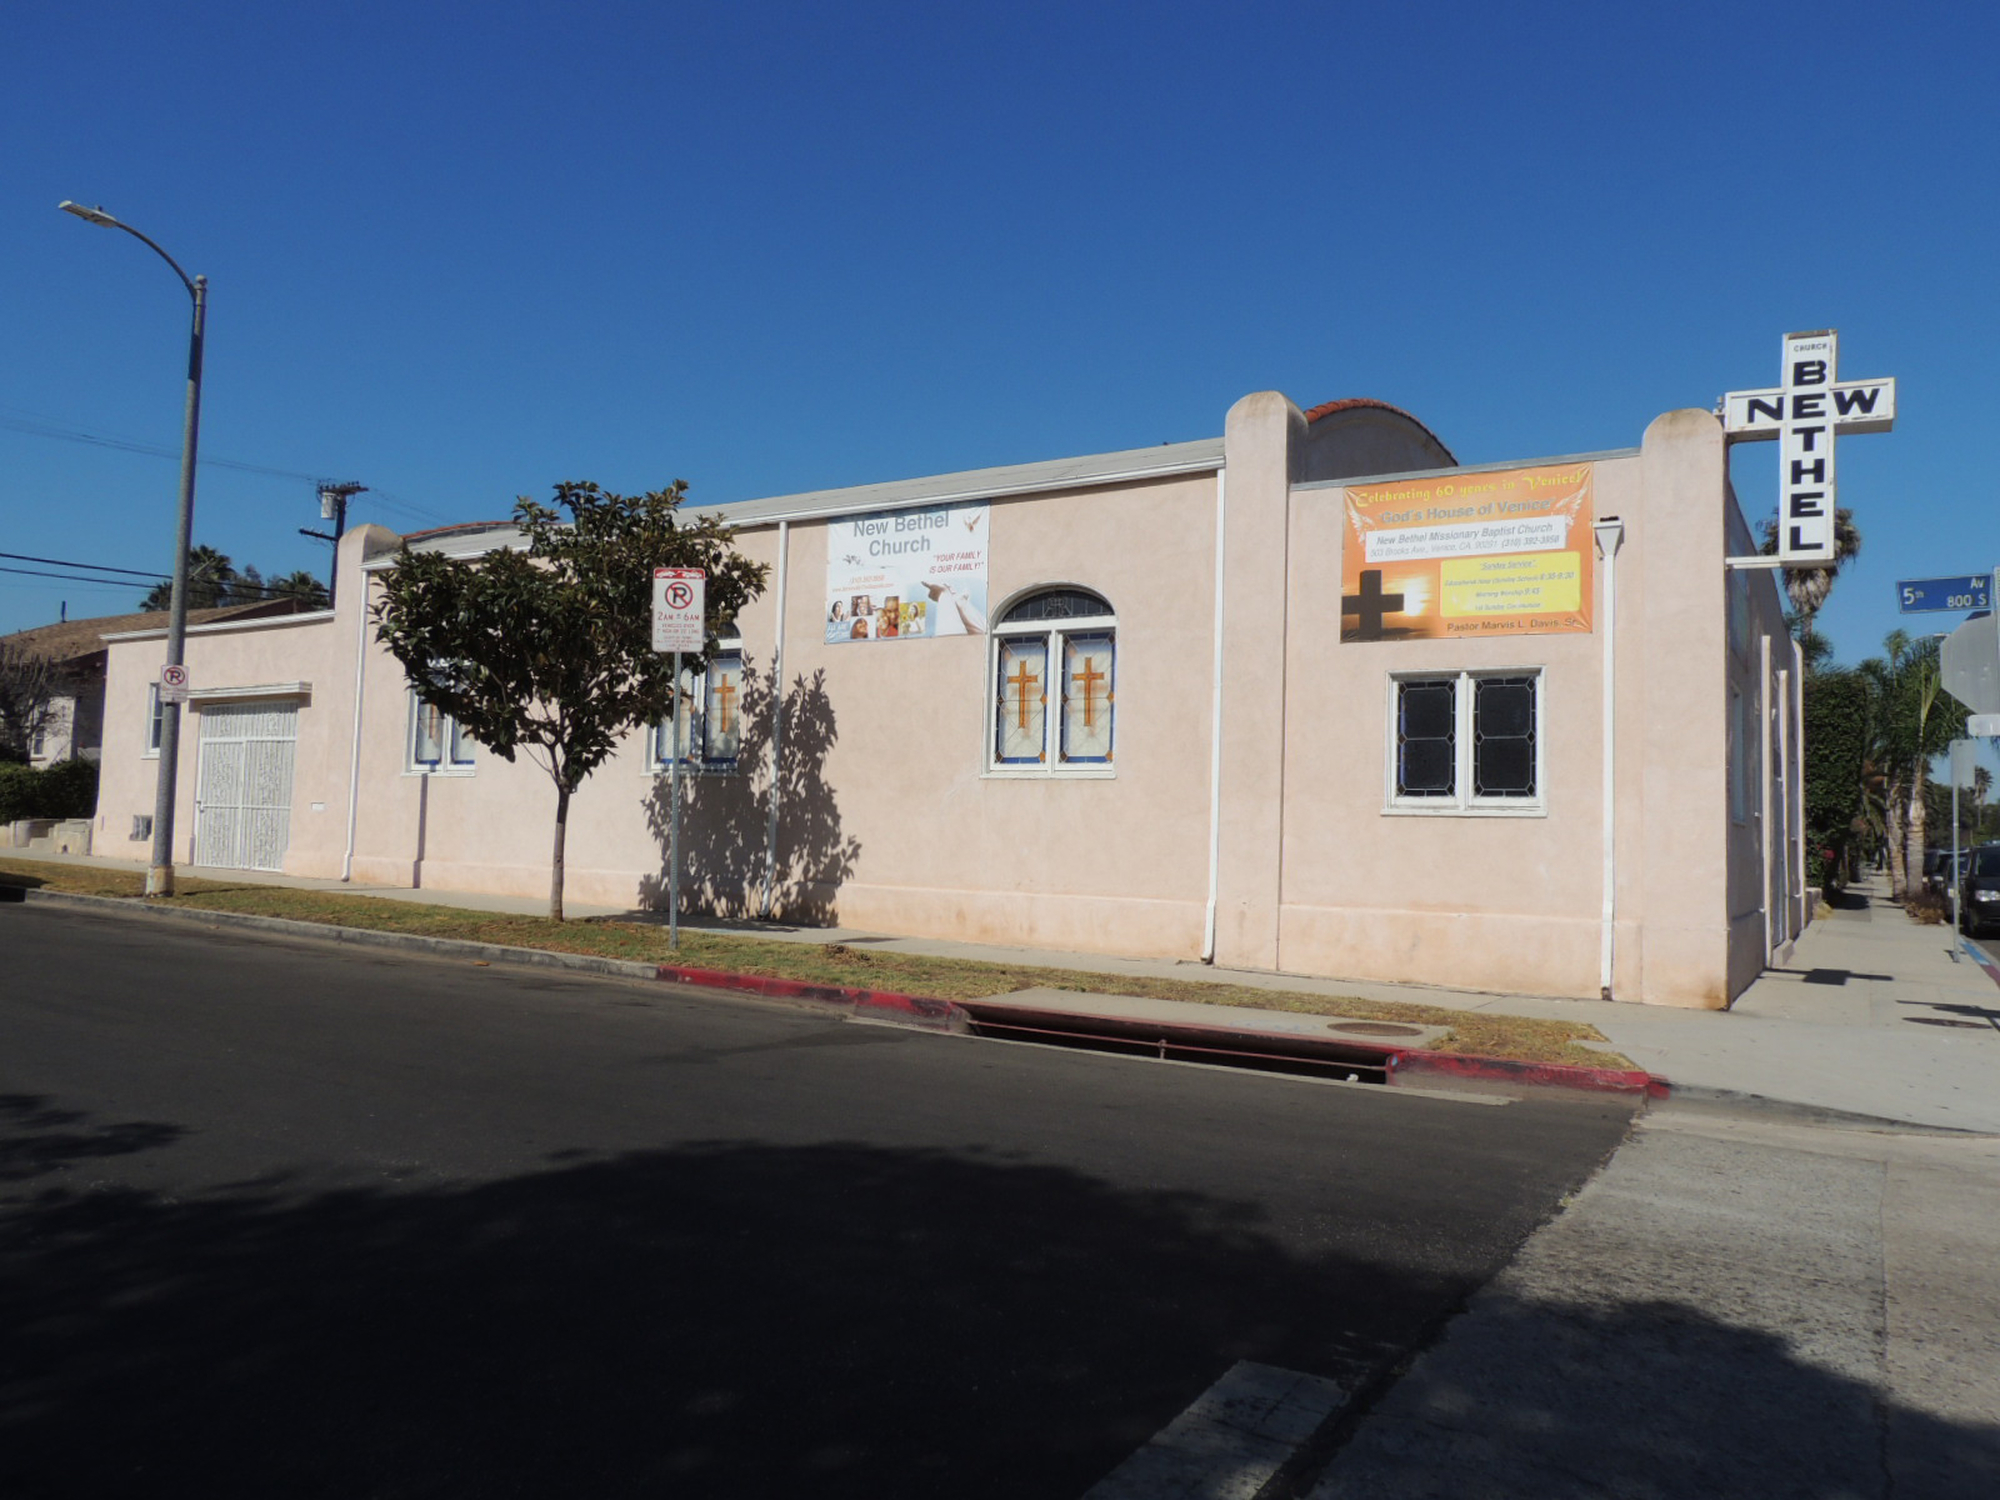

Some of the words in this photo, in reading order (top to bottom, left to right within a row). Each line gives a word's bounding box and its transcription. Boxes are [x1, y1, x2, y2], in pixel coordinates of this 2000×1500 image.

[1793, 343, 1827, 352] CHURCH
[1790, 360, 1827, 551] BETHEL
[1356, 488, 1431, 508] Celebrating
[1436, 485, 1454, 497] 60
[1502, 480, 1516, 490] in
[1427, 506, 1475, 520] House
[1478, 502, 1494, 515] of
[854, 520, 888, 537] New
[895, 510, 949, 532] Bethel
[1376, 535, 1396, 545] New
[1398, 532, 1427, 544] Bethel
[1429, 529, 1480, 541] Missionary
[1481, 525, 1515, 538] Baptist
[1517, 522, 1553, 535] Church
[869, 534, 931, 556] Church
[1947, 595, 1972, 607] 800
[1978, 594, 1987, 605] S
[1447, 621, 1479, 632] Pastor
[1481, 619, 1515, 630] Marvis
